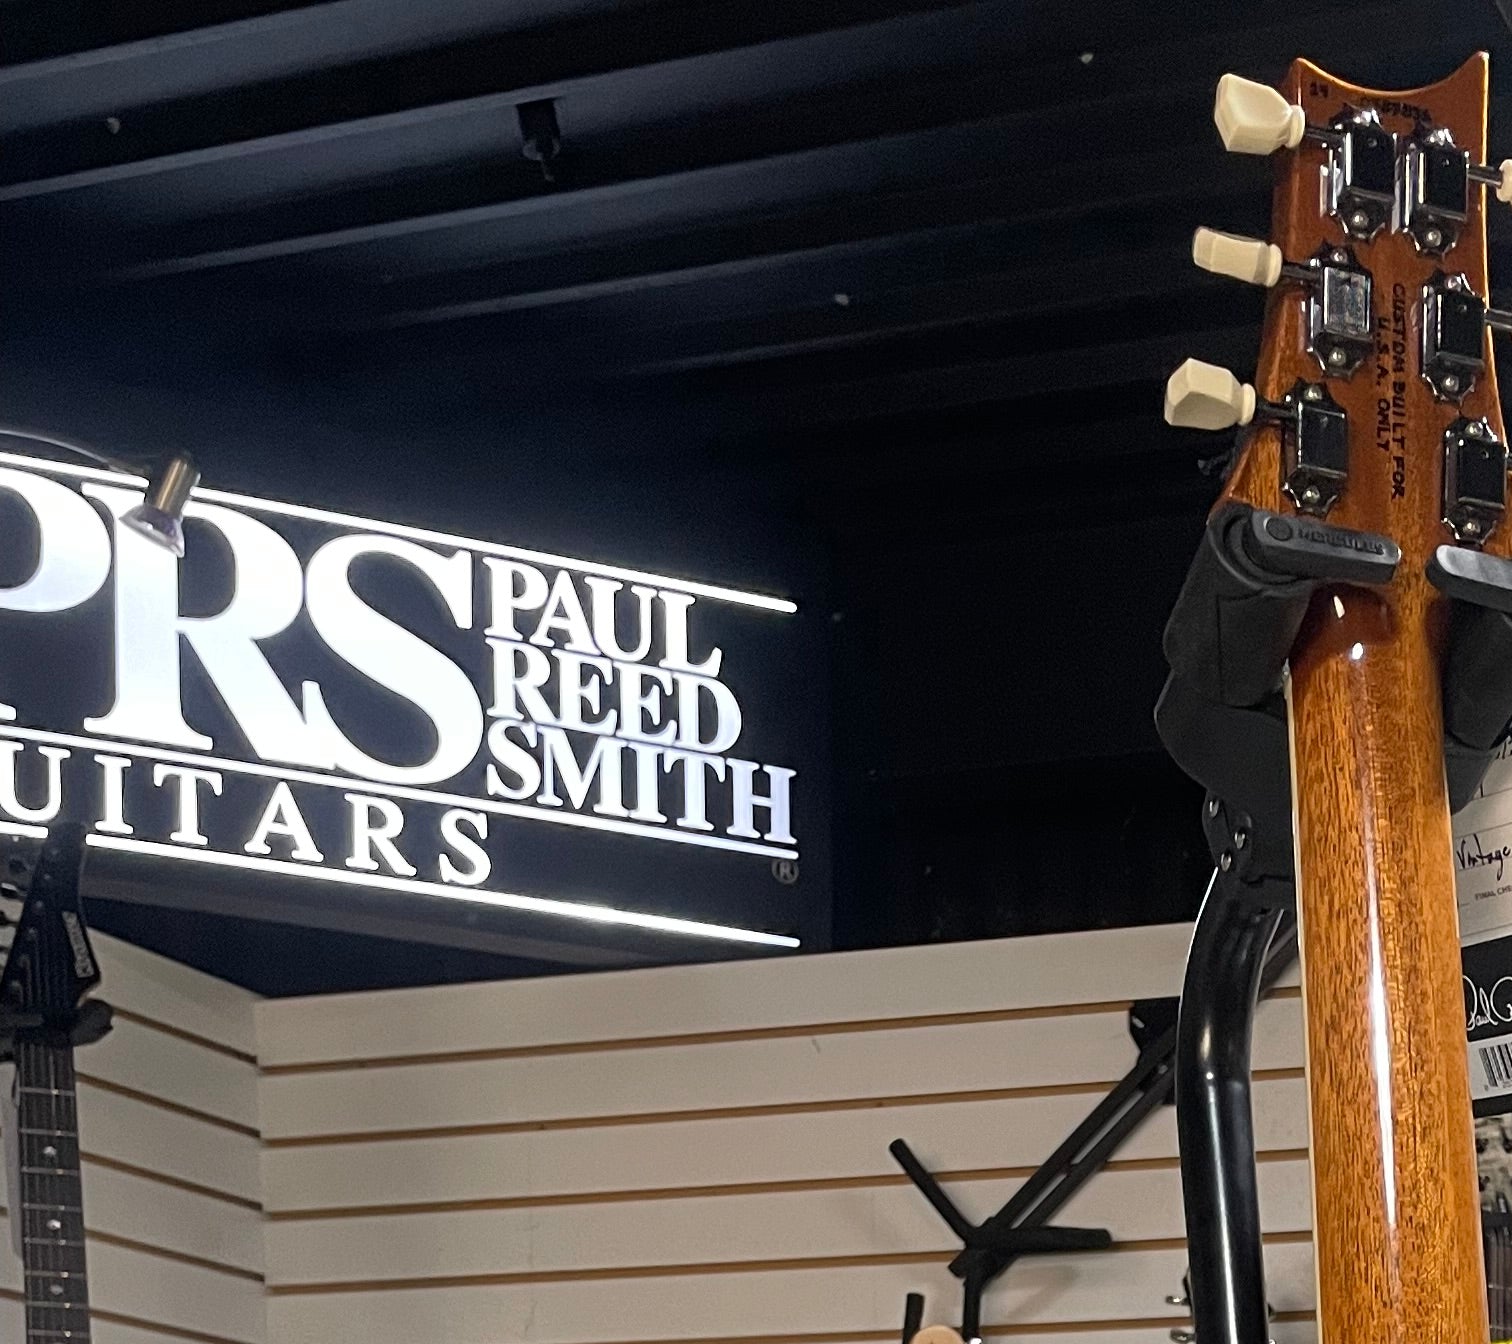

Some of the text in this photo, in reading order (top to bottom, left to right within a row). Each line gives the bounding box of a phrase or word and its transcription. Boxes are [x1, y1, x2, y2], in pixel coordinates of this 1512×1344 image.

[1376, 398, 1391, 452] ONLY
[1391, 283, 1406, 500] CUSTOM BUILT FOR
[481, 557, 723, 679] PAUL
[486, 637, 743, 755] REED
[0, 739, 493, 887] UITARS
[486, 717, 798, 846] SMITH
[1474, 890, 1496, 900] FINAL
